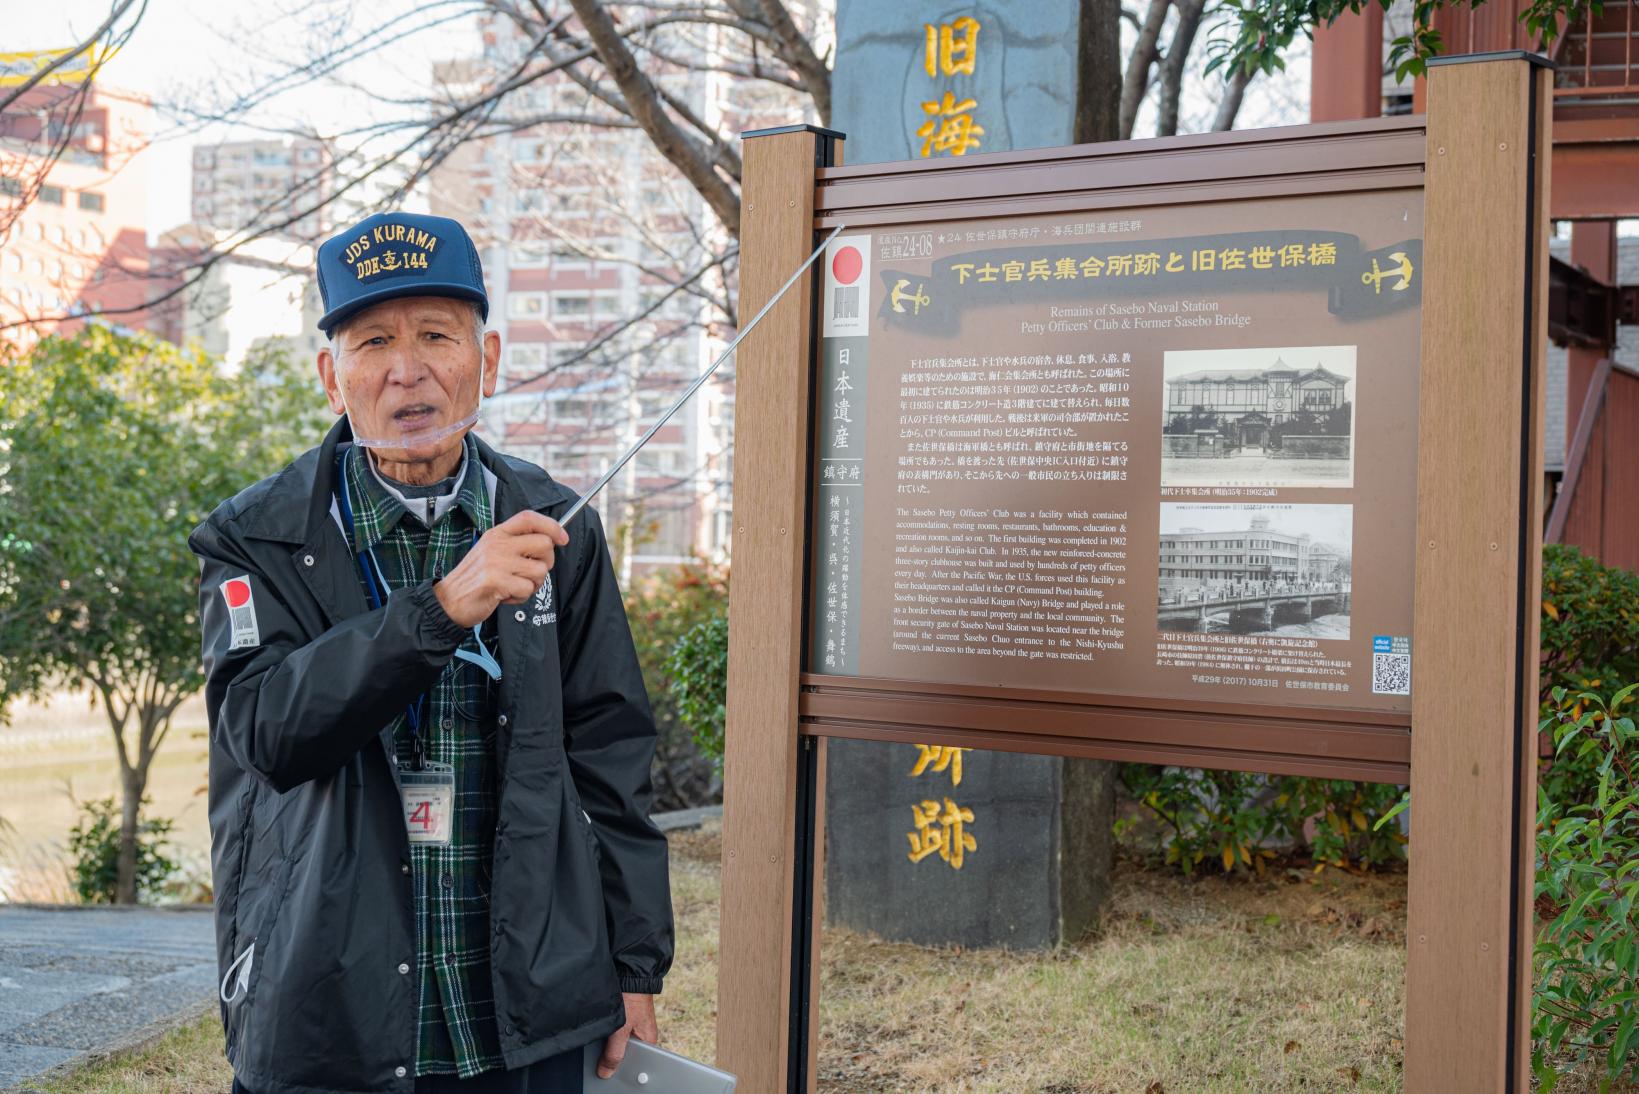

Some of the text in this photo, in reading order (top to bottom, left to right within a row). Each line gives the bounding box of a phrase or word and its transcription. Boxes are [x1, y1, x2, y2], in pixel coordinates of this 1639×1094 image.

[346, 224, 437, 264] JDS KURAMA
[356, 252, 428, 280] DDH 144
[1050, 300, 1218, 317] Remains of Sasebo Naval Station
[1021, 320, 1046, 334] Petty
[1094, 318, 1118, 329] Club
[1121, 317, 1130, 328] &
[1134, 316, 1171, 328] Former
[1174, 315, 1211, 327] Sasebo
[1215, 314, 1251, 329] Bridge
[832, 348, 853, 449] 日本遺産
[823, 465, 861, 480] 鎮守府
[896, 507, 909, 515] The
[913, 508, 935, 516] Sasebo
[939, 508, 955, 518] Petty
[992, 509, 1009, 517] Club
[1038, 510, 1062, 520] facility
[1067, 510, 1088, 518] which
[1092, 510, 1128, 520] contained
[953, 522, 974, 532] resting
[1082, 524, 1116, 532] education
[895, 532, 926, 541] recreation
[951, 533, 963, 542] and
[988, 534, 1001, 542] The
[1003, 534, 1016, 543] first
[1018, 535, 1046, 545] building
[1062, 536, 1098, 546] completed
[1110, 536, 1127, 546] 1902
[895, 544, 906, 552] and
[909, 544, 922, 553] also
[924, 545, 942, 553] called
[945, 545, 976, 556] Kaijin-kai
[1030, 548, 1041, 556] the
[1059, 548, 1126, 559] reinforced-concrete
[895, 556, 1126, 572] three-story clubhouse built and used hundreds petty officers
[894, 571, 911, 581] every
[931, 570, 947, 578] After
[950, 571, 960, 579] the
[963, 571, 985, 579] Pacific
[1005, 572, 1015, 580] the
[1034, 573, 1055, 581] forces
[1057, 574, 1073, 582] used
[1075, 574, 1088, 582] this
[1091, 574, 1114, 585] facility
[910, 581, 950, 593] headquarters
[952, 583, 963, 591] and
[965, 583, 984, 592] called
[992, 584, 1002, 593] the
[1004, 585, 1015, 593] CP
[1016, 585, 1053, 596] (Command
[894, 593, 916, 602] Sasebo
[918, 594, 938, 605] Bridge
[954, 596, 967, 604] also
[969, 596, 989, 605] called
[991, 597, 1015, 608] Kaigun
[1041, 599, 1064, 609] Bridge
[1066, 600, 1078, 608] and
[1080, 600, 1103, 611] played
[1111, 601, 1125, 611] role
[908, 606, 928, 615] border
[930, 607, 956, 616] between
[958, 608, 968, 616] the
[970, 608, 987, 617] naval
[989, 609, 1017, 620] property
[1019, 611, 1032, 619] and
[1034, 611, 1044, 620] the
[1047, 612, 1063, 620] local
[1110, 614, 1125, 624] The
[910, 618, 934, 629] security
[936, 620, 950, 630] gate
[960, 621, 983, 630] Sasebo
[985, 622, 1003, 630] Naval
[1005, 623, 1029, 631] Station
[1046, 624, 1070, 633] located
[1089, 626, 1100, 635] the
[1101, 627, 1125, 638] bridge
[921, 631, 931, 639] the
[936, 632, 959, 641] current
[963, 633, 987, 642] Sasebo
[991, 634, 1010, 643] Chuo
[1014, 635, 1043, 645] entrance
[1059, 638, 1071, 646] the
[1075, 638, 1125, 651] Nishi-Kyushu
[922, 644, 933, 652] and
[992, 647, 1016, 658] beyond
[1029, 649, 1043, 659] gate
[409, 801, 434, 830] 4
